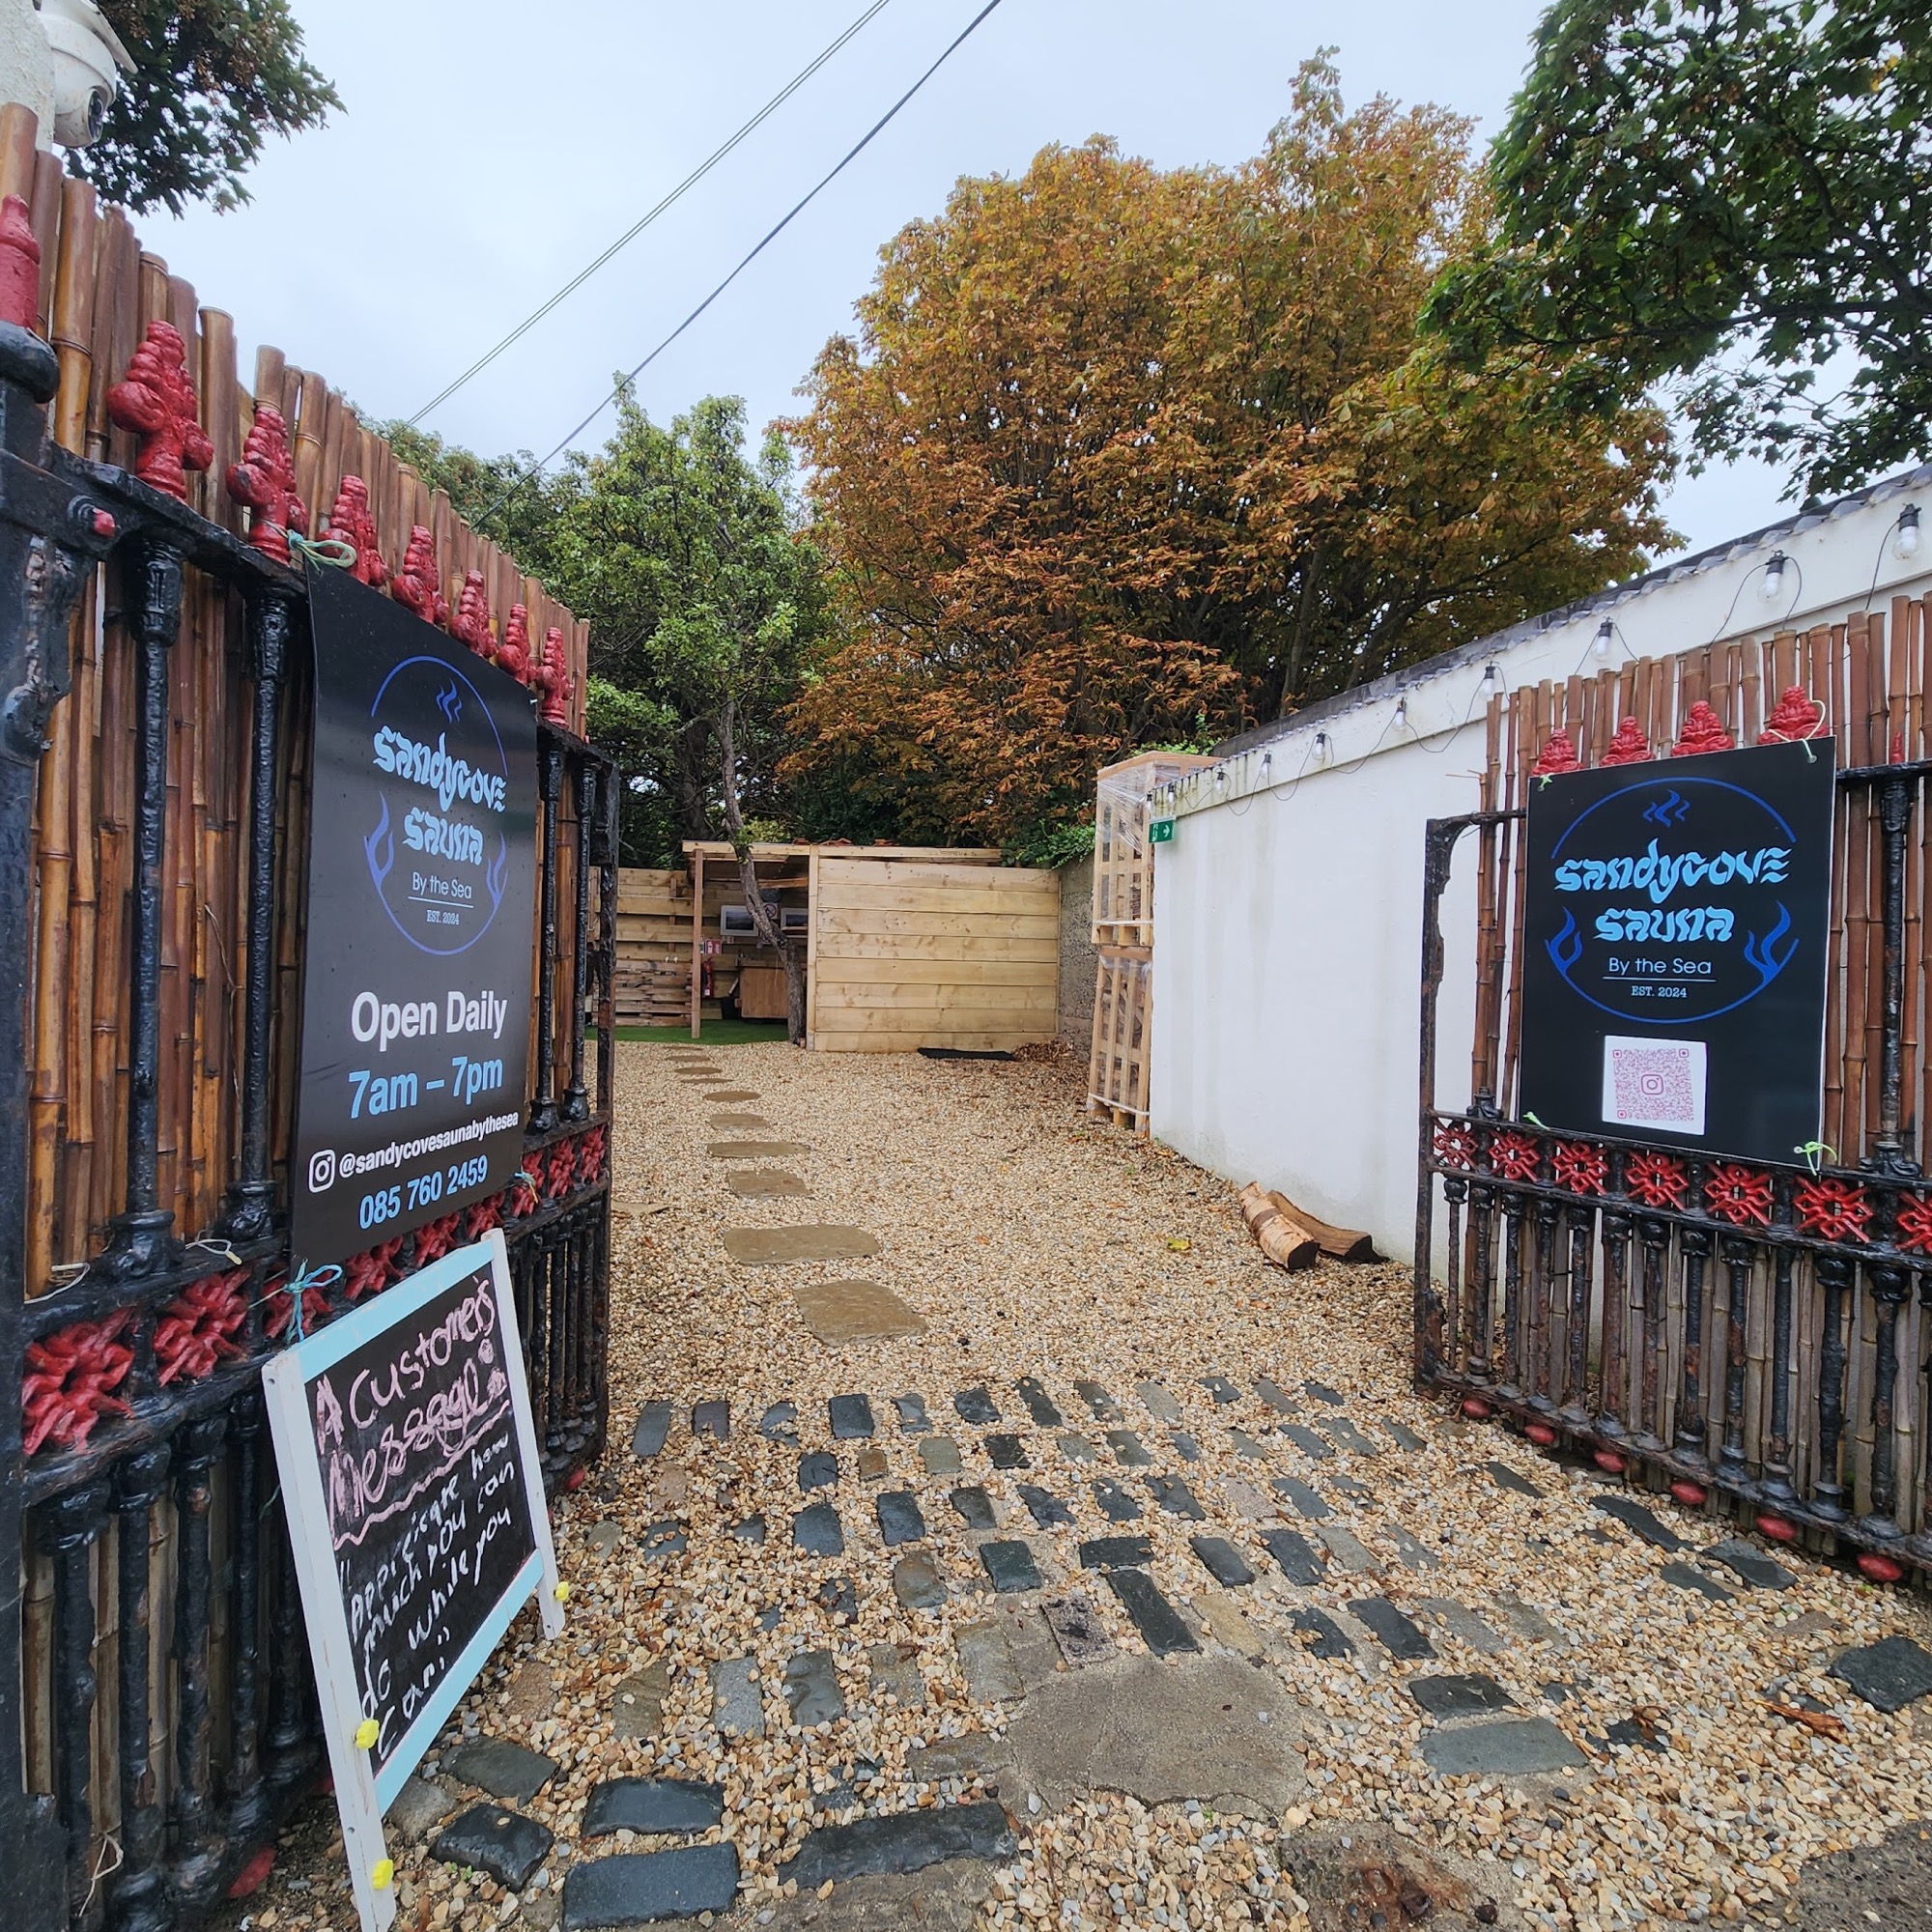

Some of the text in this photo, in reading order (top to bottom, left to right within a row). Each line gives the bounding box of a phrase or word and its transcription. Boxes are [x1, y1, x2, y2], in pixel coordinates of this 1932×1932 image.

[412, 871, 472, 899] By the Sea
[426, 909, 460, 925] EST. 2024
[1608, 956, 1712, 977] By the Sea
[1631, 984, 1688, 999] EST. 2024
[352, 990, 508, 1052] Open Daily
[348, 1070, 418, 1119] 7am
[452, 1056, 503, 1105] 7pm
[339, 1111, 519, 1178] @sandycovesaunabythesea
[358, 1154, 489, 1230] 085 760 2459
[316, 1374, 345, 1455] A
[470, 1433, 510, 1481] how
[363, 1461, 515, 1662] much you can
[361, 1507, 511, 1719] do while you
